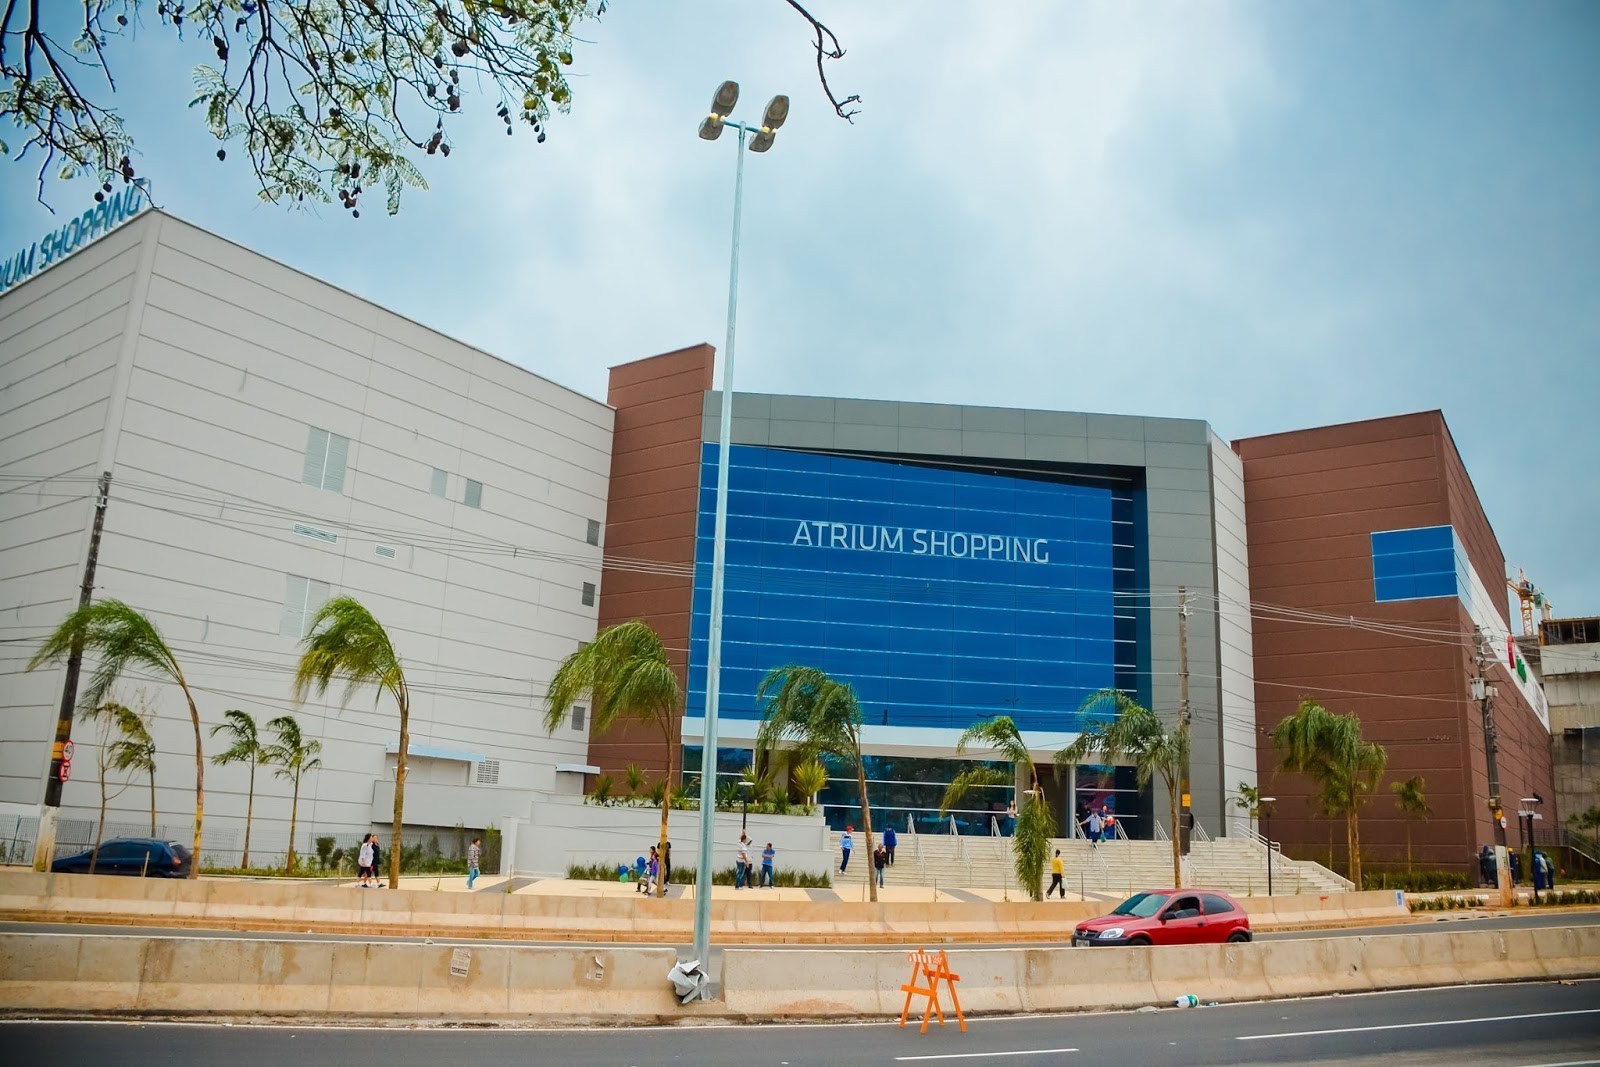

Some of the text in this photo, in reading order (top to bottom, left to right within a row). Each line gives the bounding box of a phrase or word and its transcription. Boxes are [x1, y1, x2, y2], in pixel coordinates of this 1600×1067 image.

[39, 177, 147, 270] SHOPPING
[792, 521, 1049, 563] ATRIUM SHOPPING
